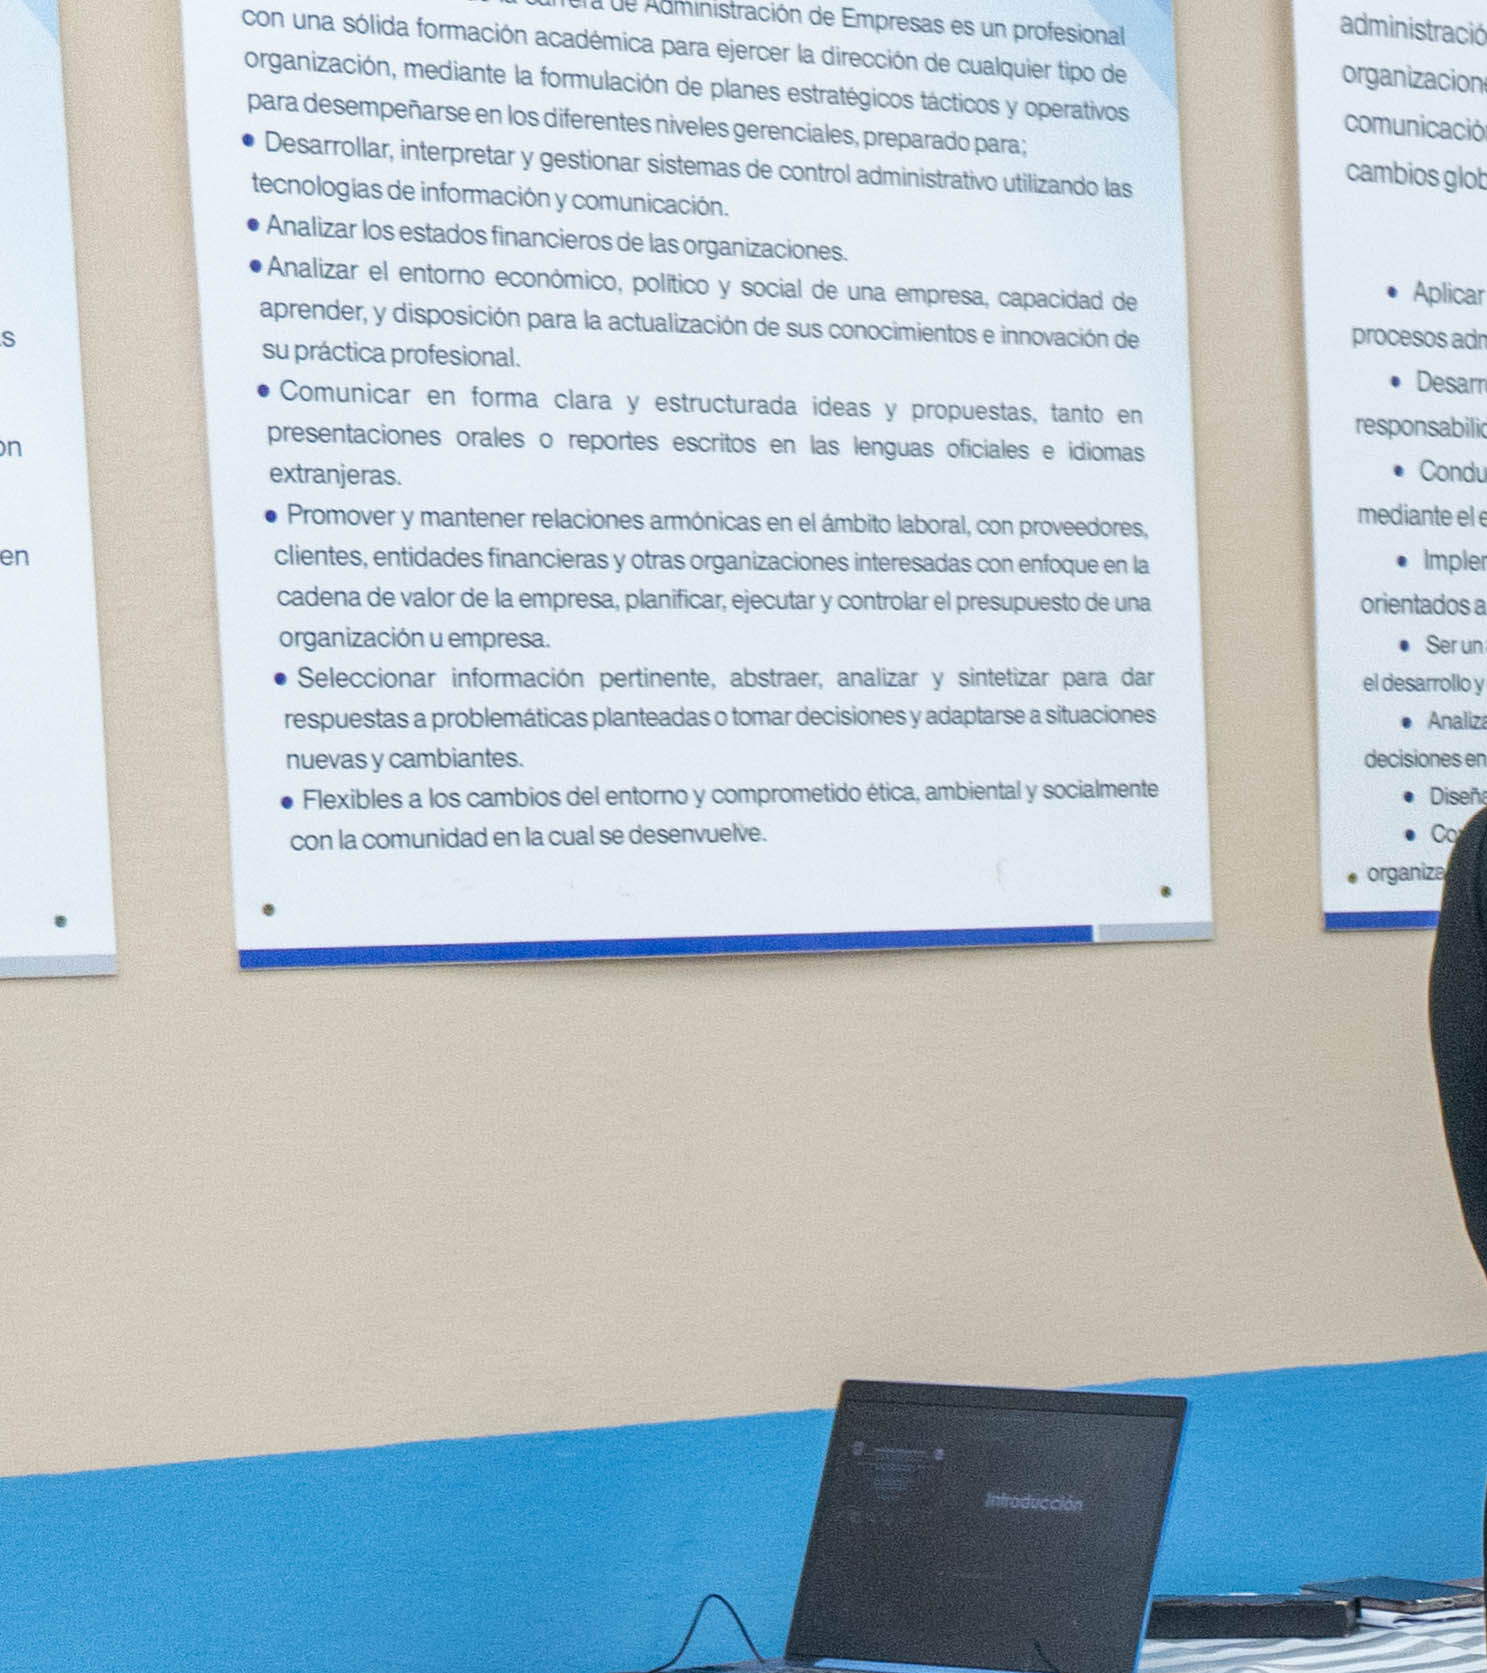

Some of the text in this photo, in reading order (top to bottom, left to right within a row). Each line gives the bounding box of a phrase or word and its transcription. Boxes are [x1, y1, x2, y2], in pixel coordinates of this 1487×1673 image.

[1345, 161, 1441, 187] cambios
[265, 213, 848, 261] Analizar los estados financieros de las organizaciones.
[1412, 280, 1486, 307] Aplicar
[261, 340, 521, 368] su práctica profesional.
[278, 378, 1144, 424] Comunicar en forma clara y estructurada ideas y propuestas, tanto en
[268, 463, 402, 490] extranjeras.
[278, 627, 551, 652] organización u empresa.
[285, 747, 524, 773] nuevas y cambiantes.
[289, 822, 767, 851] con la comunidad en la cual se desenvuelve.
